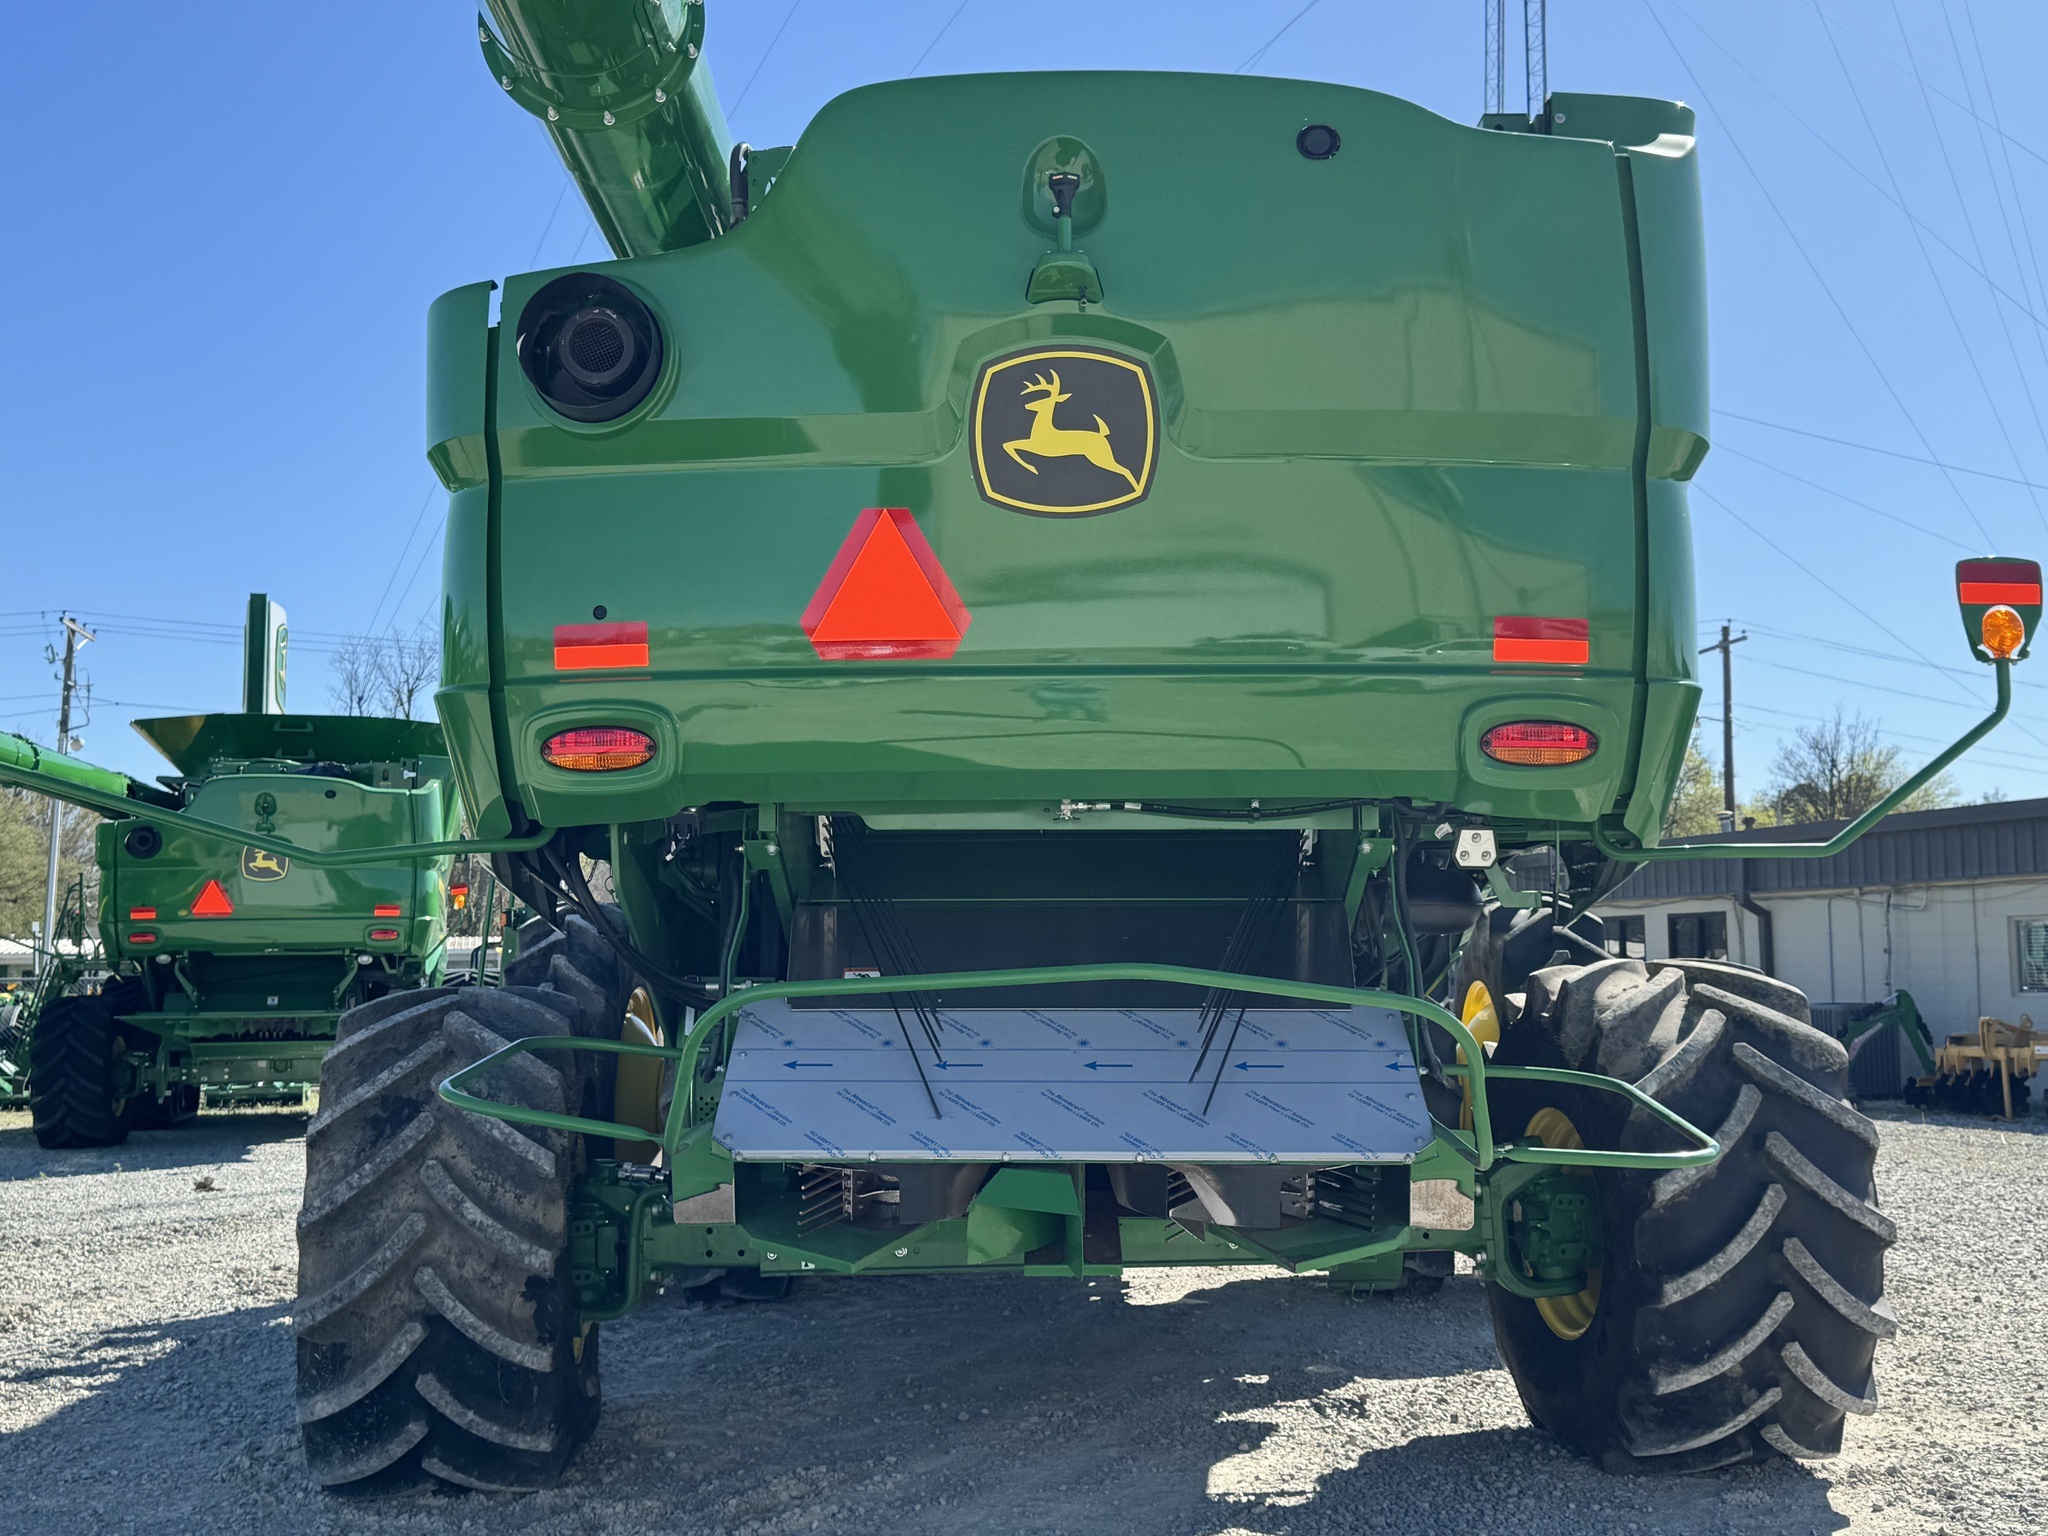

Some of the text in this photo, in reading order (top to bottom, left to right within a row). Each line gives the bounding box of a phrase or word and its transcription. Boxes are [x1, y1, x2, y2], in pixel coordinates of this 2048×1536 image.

[739, 1094, 754, 1104] LASER
[764, 1111, 779, 1121] LASER
[842, 1094, 856, 1104] LASER
[868, 1111, 883, 1121] LASER
[944, 1095, 959, 1105] LASER
[972, 1111, 988, 1121] LASER
[1046, 1095, 1062, 1105] LASER
[1075, 1112, 1091, 1122] LASER
[1148, 1096, 1165, 1106] LASER
[1179, 1112, 1196, 1123] LASER
[1252, 1096, 1268, 1106] LASER
[1283, 1113, 1300, 1123] LASER
[1355, 1096, 1372, 1106] LASER
[1388, 1113, 1405, 1124] LASER
